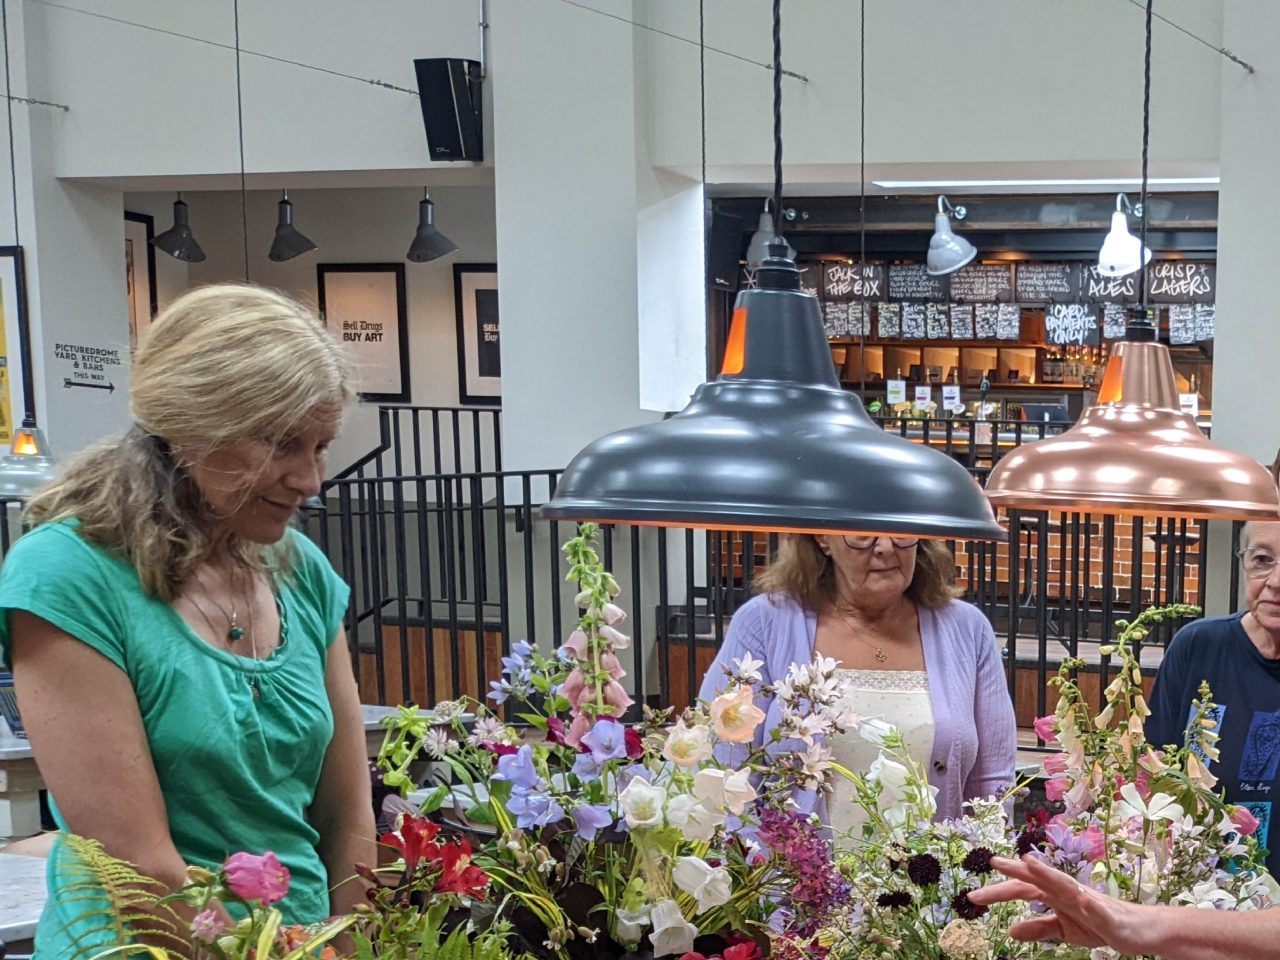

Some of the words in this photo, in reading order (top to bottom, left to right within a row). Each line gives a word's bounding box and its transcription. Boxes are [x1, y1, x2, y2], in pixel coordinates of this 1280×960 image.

[828, 266, 859, 281] JACK
[862, 265, 874, 278] IN
[1155, 264, 1196, 281] CRISP
[827, 282, 852, 296] THE
[853, 280, 880, 296] BOX
[1089, 279, 1134, 297] ALES
[1151, 276, 1210, 296] LAGERS
[1054, 304, 1084, 318] CARD
[343, 321, 358, 331] Sell
[359, 321, 383, 333] Drugs
[343, 333, 362, 342] BUY
[364, 333, 383, 342] ART
[55, 344, 119, 358] PICTUREDROME
[73, 361, 79, 369] &
[83, 362, 104, 371] BARS
[82, 355, 121, 366] KITCHENS
